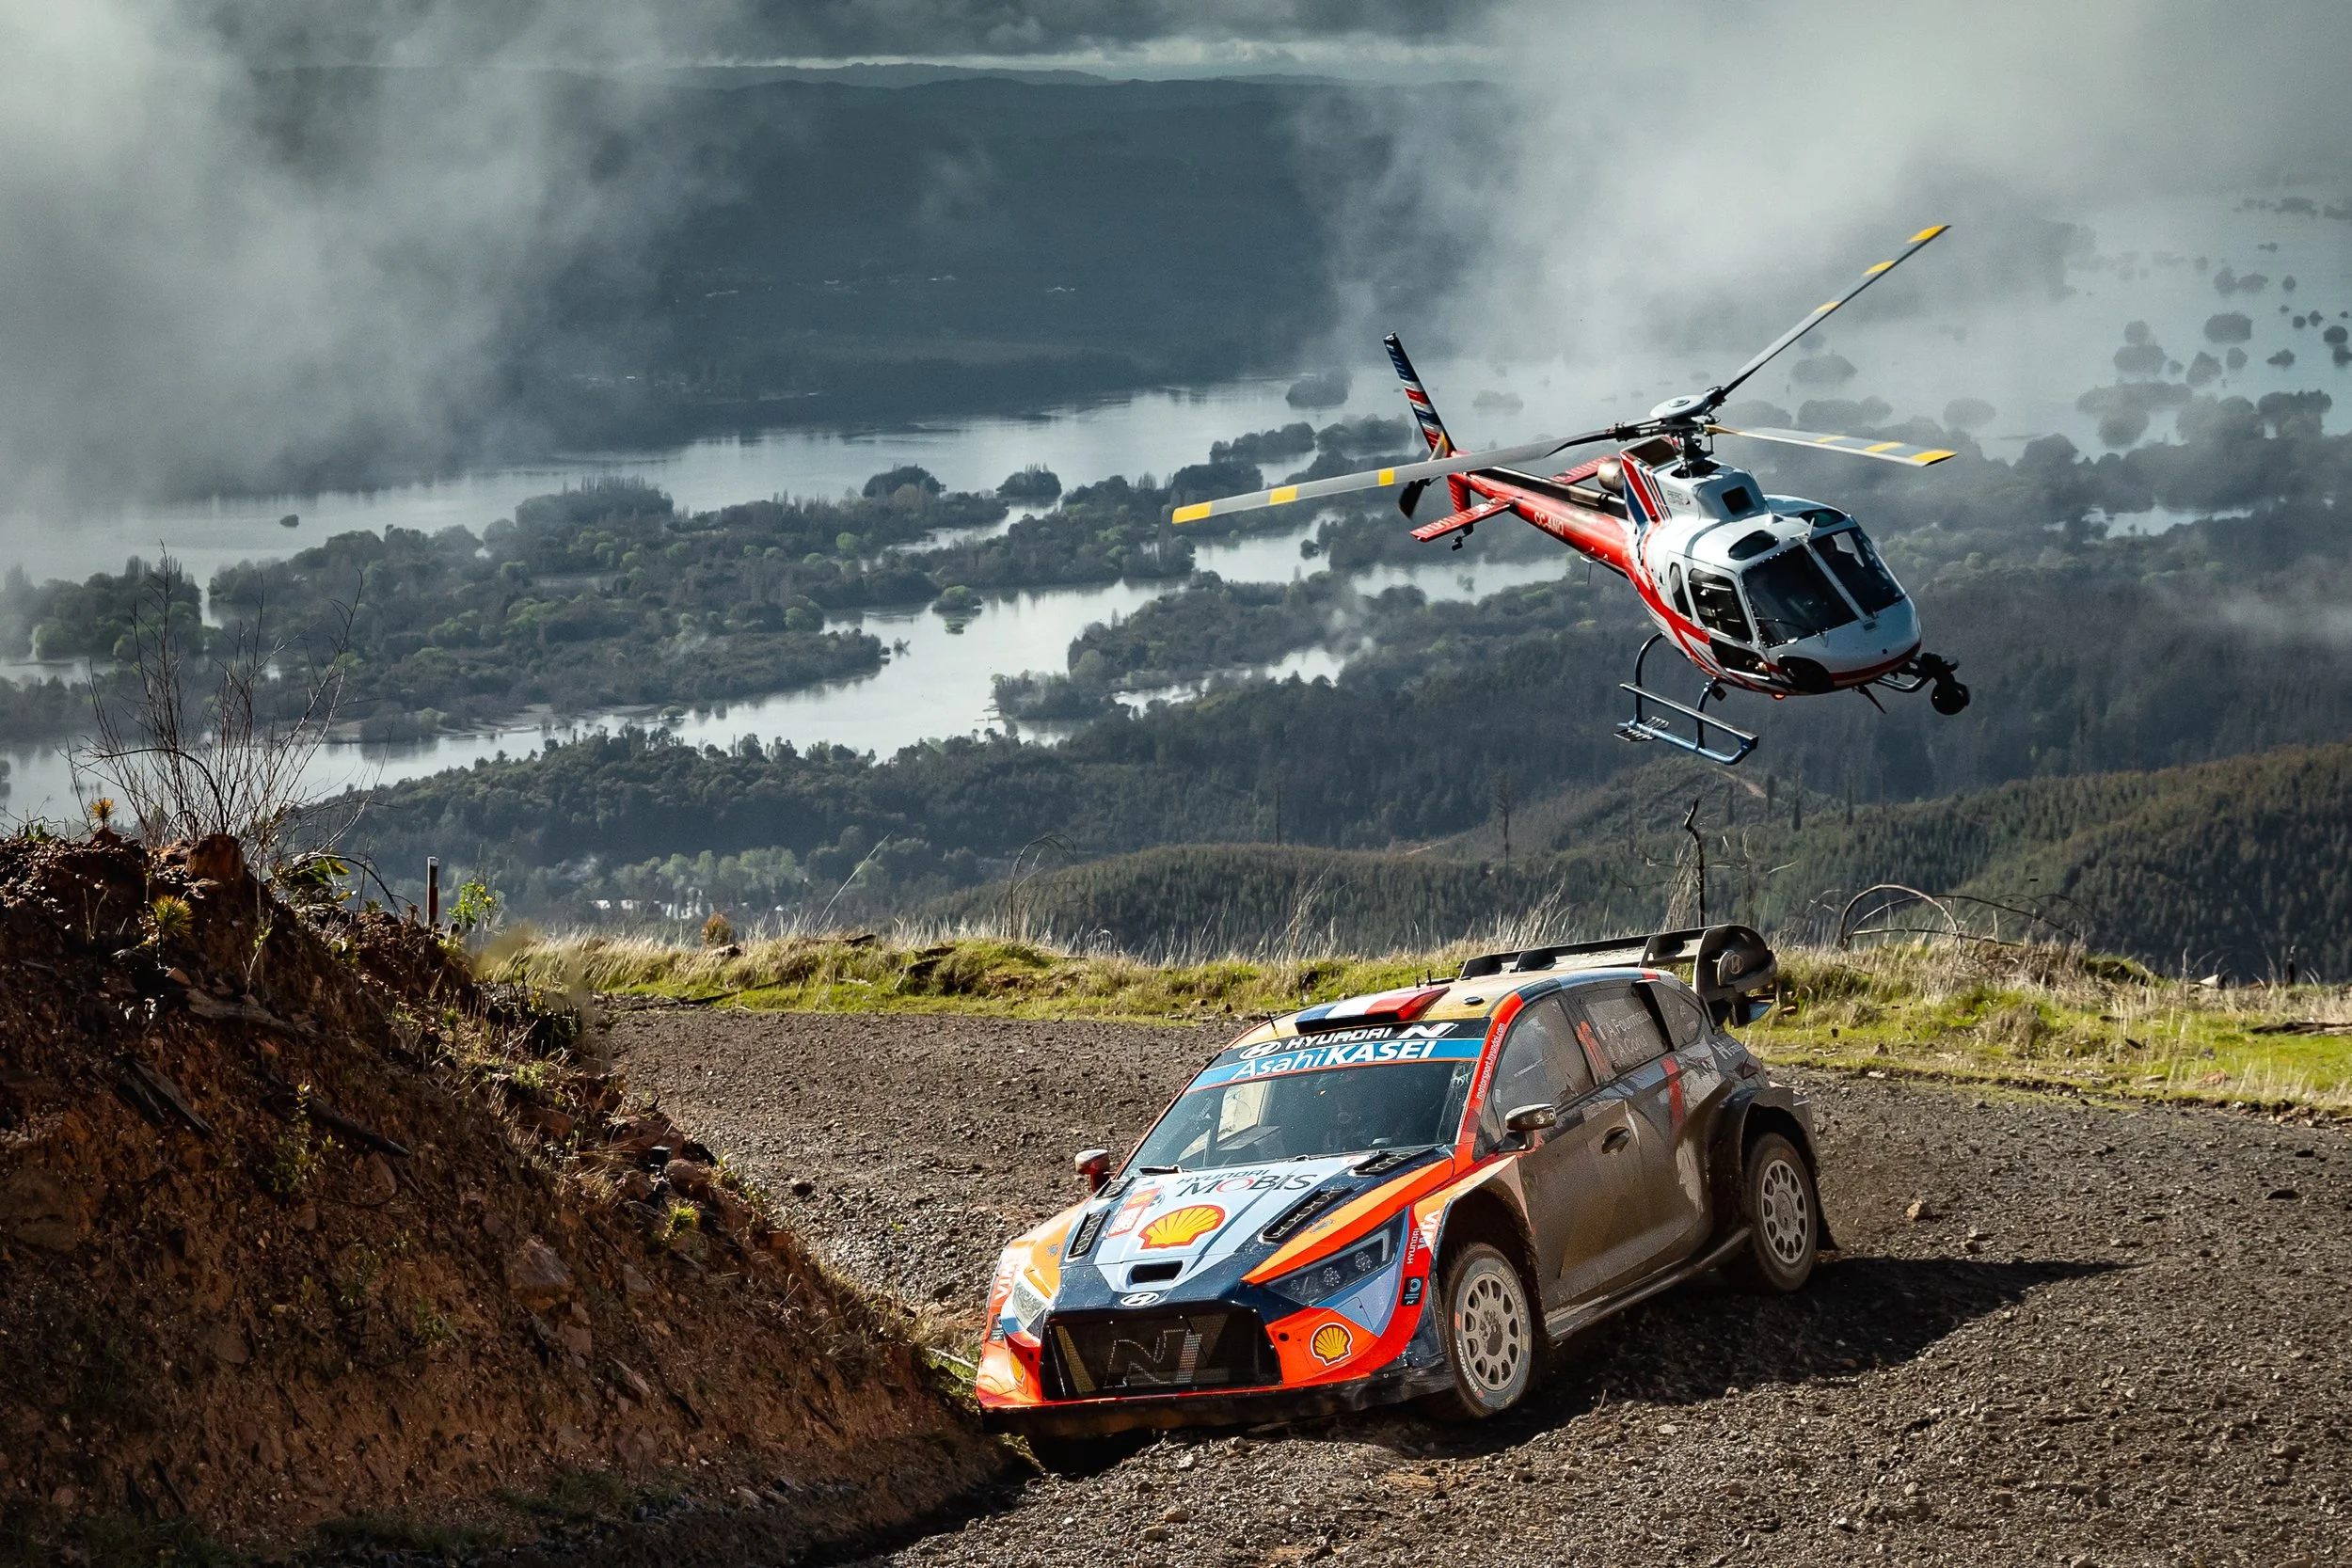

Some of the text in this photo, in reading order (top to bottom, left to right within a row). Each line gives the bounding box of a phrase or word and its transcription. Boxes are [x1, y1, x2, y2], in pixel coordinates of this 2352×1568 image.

[1285, 1027, 1392, 1051] HYUNDAI
[1477, 1022, 1505, 1100] motorsport.hyundai.com
[1176, 1174, 1318, 1197] MOBIS
[1406, 1227, 1421, 1265] HYUNDAI
